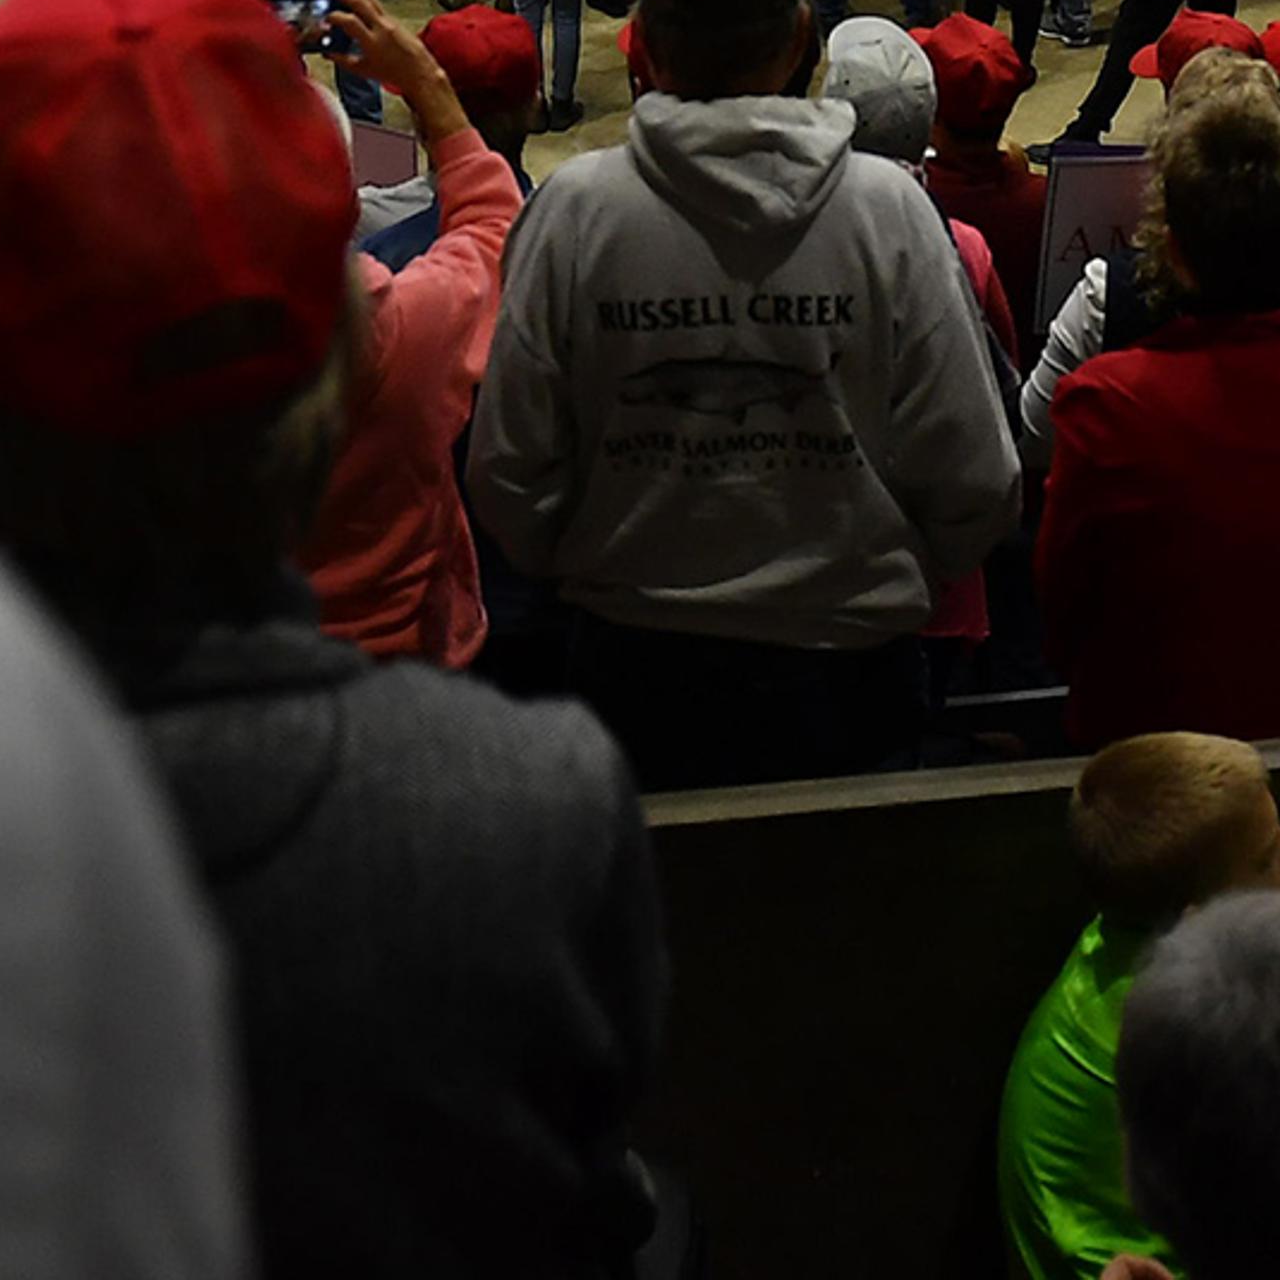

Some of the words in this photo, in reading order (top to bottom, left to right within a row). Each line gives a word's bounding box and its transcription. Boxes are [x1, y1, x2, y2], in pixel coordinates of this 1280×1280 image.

[598, 296, 736, 331] RUSSELL
[747, 295, 854, 326] CREEK
[681, 431, 786, 458] SALMON
[796, 430, 858, 454] DERB
